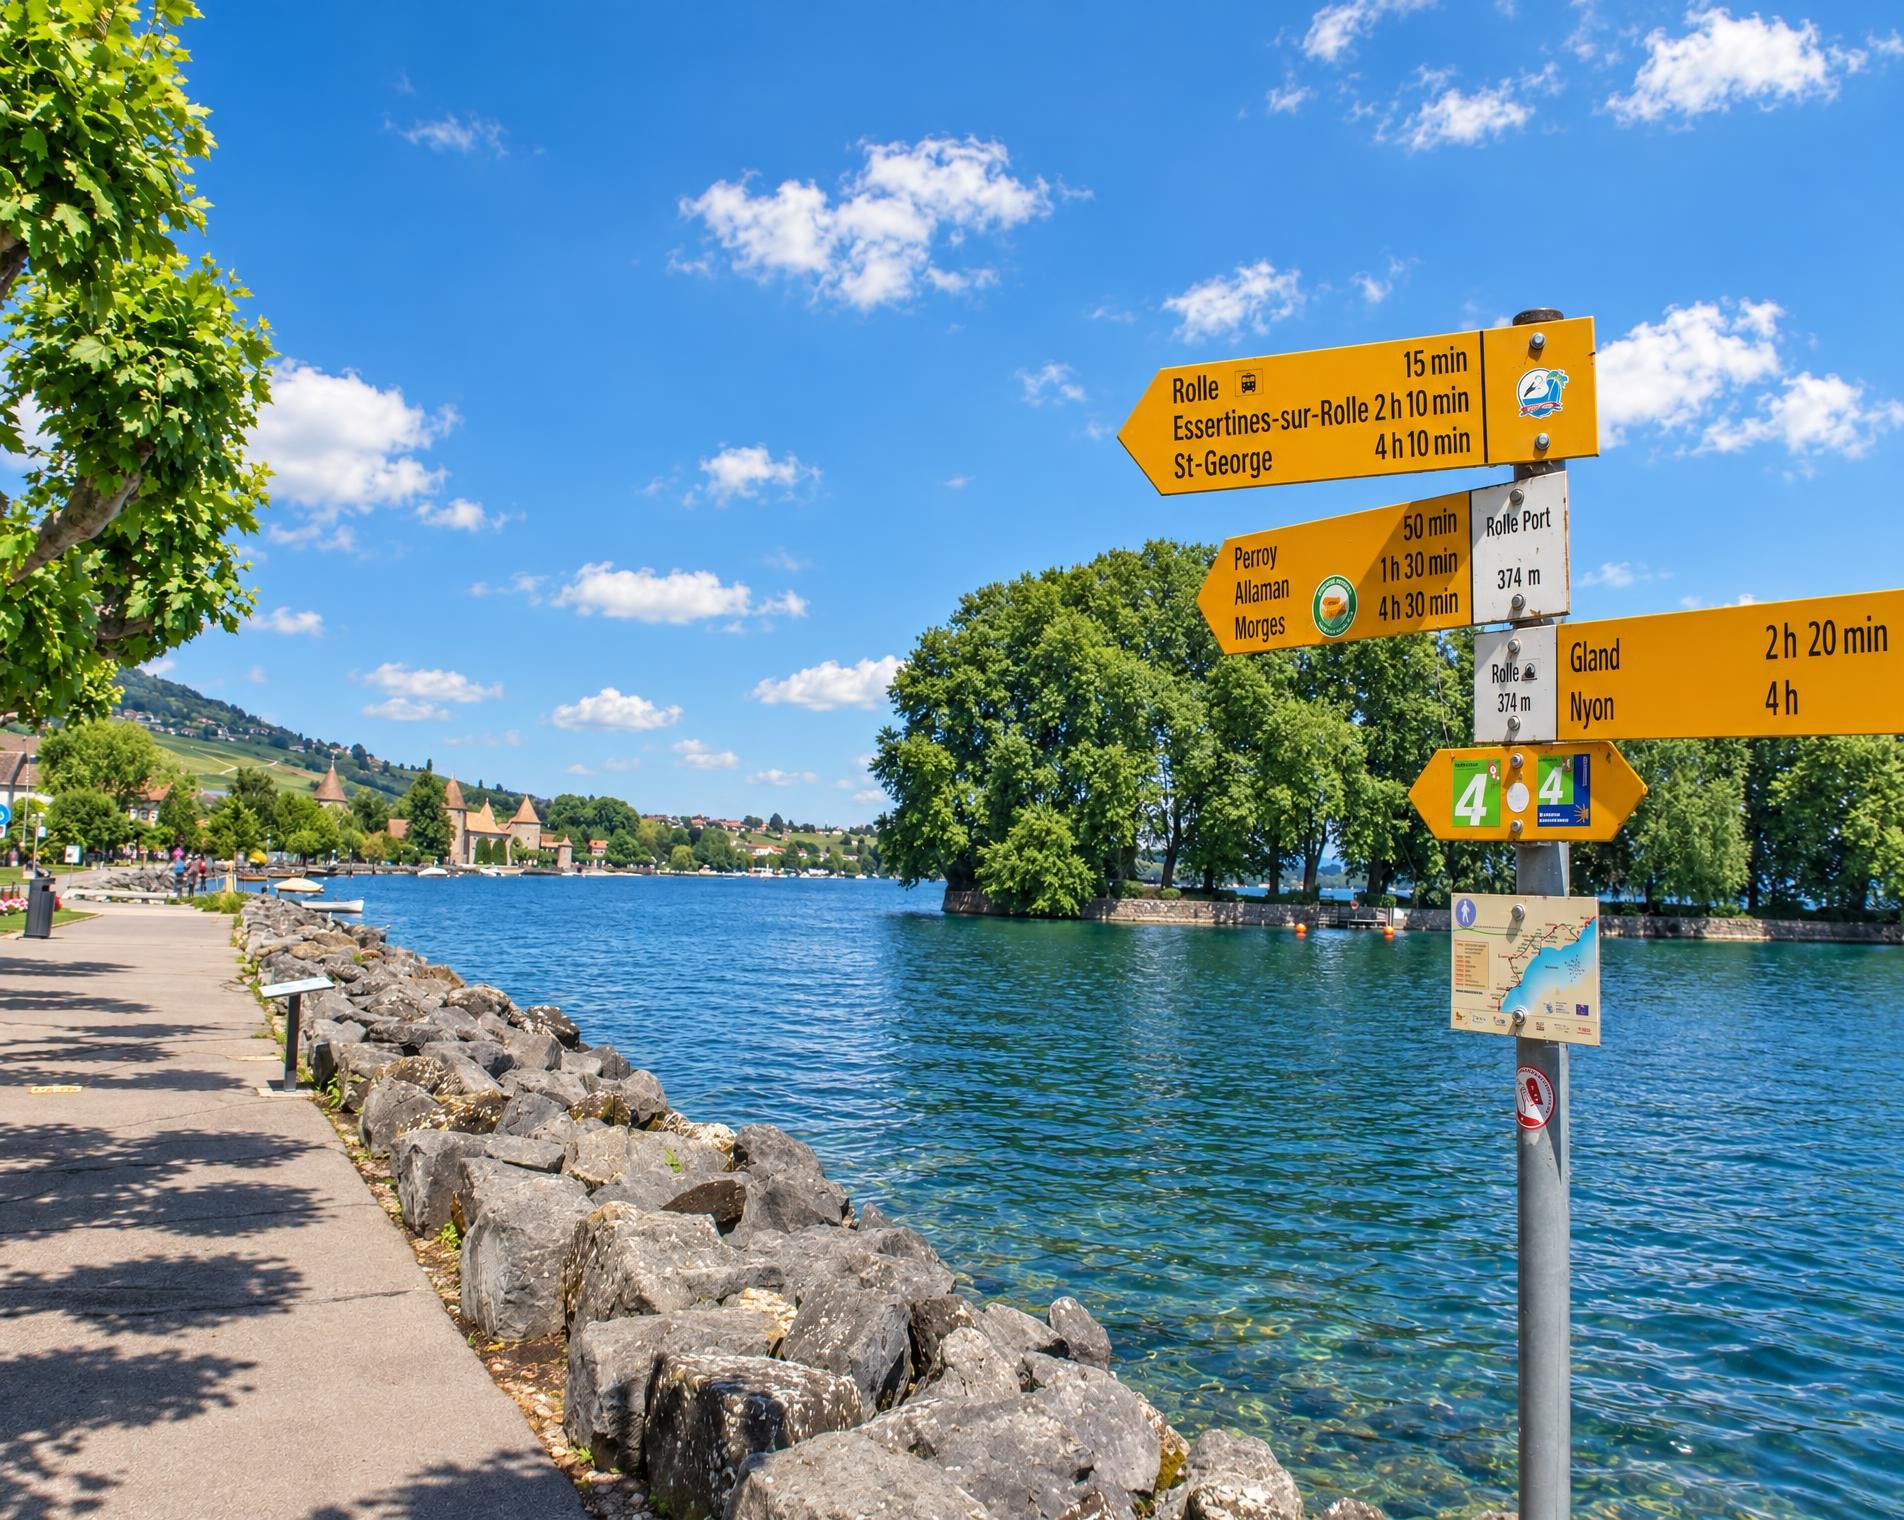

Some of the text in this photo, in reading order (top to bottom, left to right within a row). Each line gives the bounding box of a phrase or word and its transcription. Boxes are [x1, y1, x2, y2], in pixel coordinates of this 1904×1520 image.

[1173, 346, 1467, 403] Rolle 15 min
[1174, 396, 1368, 441] Essertines-sur-Rolle
[1407, 390, 1427, 417] 10
[1433, 386, 1469, 415] min
[1175, 450, 1272, 479] St-George
[1408, 430, 1428, 457] 10
[1434, 426, 1470, 455] min
[1235, 508, 1456, 570] Perroy 50 min
[1486, 507, 1551, 537] Rolle Port
[1235, 579, 1289, 605] Allaman
[1405, 552, 1424, 579] 30
[1429, 548, 1457, 576] min
[1498, 567, 1540, 589] 374 m
[1235, 616, 1285, 642] Morges
[1405, 591, 1424, 618] 30
[1430, 587, 1458, 615] min
[1571, 638, 1619, 672] Gland
[1809, 620, 1836, 656] 20
[1844, 616, 1887, 654] min
[1492, 660, 1519, 683] Rolle
[1498, 693, 1530, 712] 374 m
[1571, 692, 1614, 729] Nyon
[1455, 773, 1487, 826] 4
[1539, 766, 1563, 805] 4
